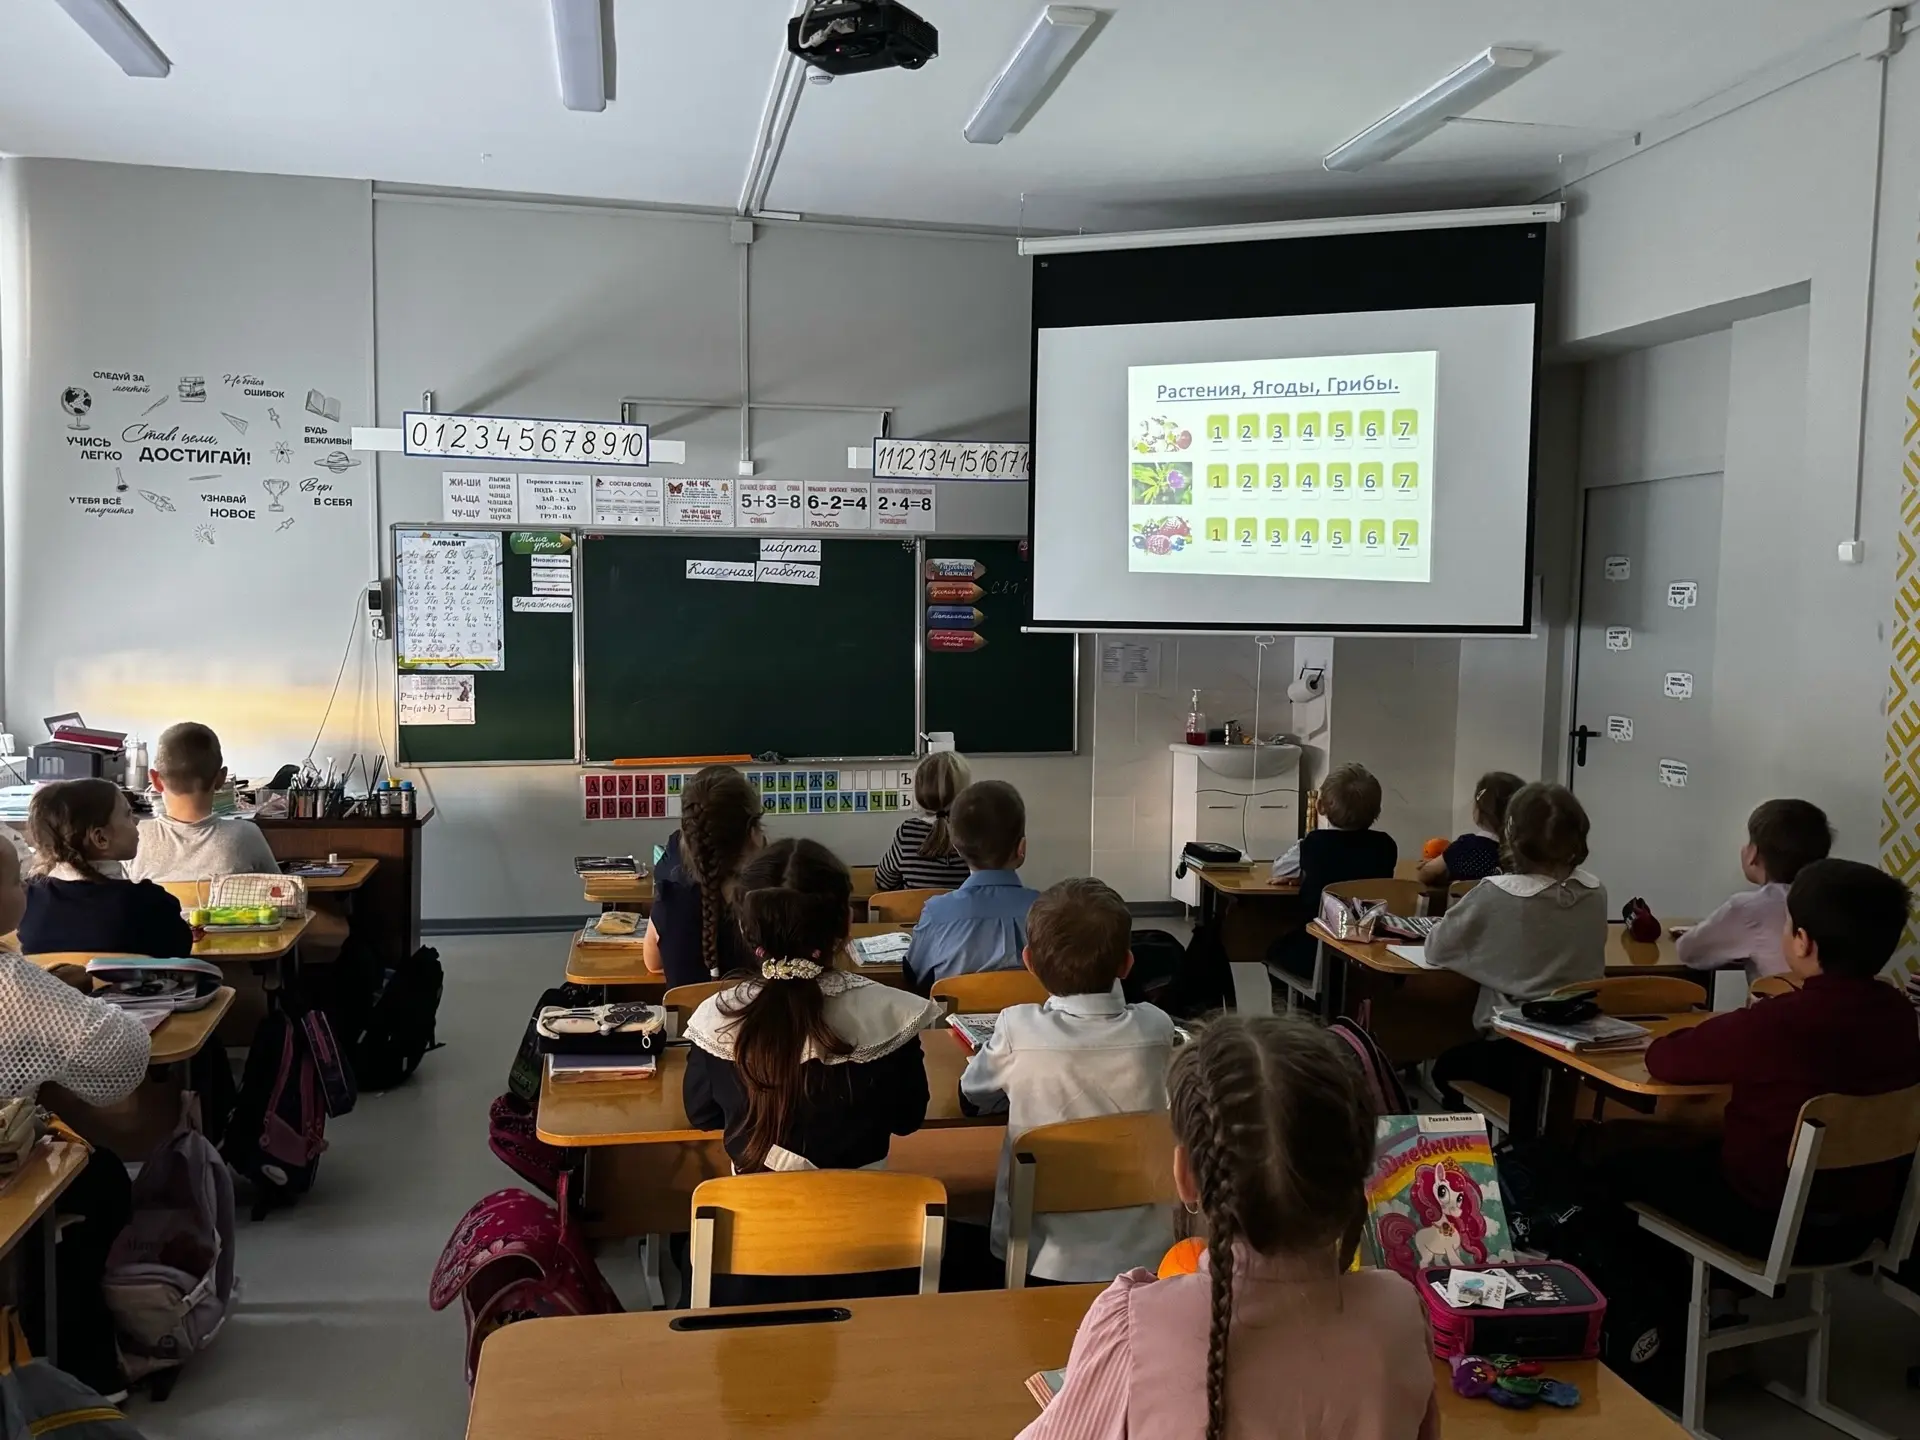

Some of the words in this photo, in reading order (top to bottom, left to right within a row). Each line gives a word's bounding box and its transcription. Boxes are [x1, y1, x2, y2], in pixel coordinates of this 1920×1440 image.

[93, 371, 130, 381] СЛЕДУЙ
[132, 374, 144, 382] ЗА
[1157, 383, 1246, 399] Растения,
[1252, 380, 1321, 397] Ягоды,
[1328, 375, 1399, 394] Грибы.
[244, 388, 285, 398] ОШИБОК
[304, 426, 328, 434] БУДЬ
[1214, 426, 1222, 439] 1
[1242, 426, 1251, 439] 2
[1273, 425, 1282, 438] 3
[1303, 424, 1314, 437] 4
[1334, 424, 1344, 438] 5
[1366, 423, 1376, 437] 6
[1400, 422, 1410, 436] 7
[66, 436, 112, 447] УЧИСЬ
[412, 422, 428, 446] 0
[436, 424, 445, 447] 1
[450, 424, 467, 448] 2
[475, 425, 489, 450] 3
[496, 426, 510, 450] 4
[519, 428, 534, 452] 5
[542, 428, 556, 452] 6
[562, 430, 576, 453] 7
[582, 431, 596, 454] 8
[602, 432, 616, 455] 9
[622, 433, 643, 456] 10
[80, 450, 122, 461] ЛЕГКО
[138, 447, 251, 465] ДОСТИГАЙ!
[879, 447, 895, 469] 11
[897, 448, 915, 470] 12
[918, 448, 936, 471] 13
[939, 450, 956, 472] 14
[960, 450, 977, 472] 15
[980, 450, 998, 472] 16
[1000, 450, 1019, 473] 17
[449, 478, 481, 487] ЖИ-ШИ
[1213, 476, 1222, 488] 1
[1243, 475, 1252, 488] 2
[1272, 475, 1282, 488] 3
[1302, 475, 1312, 488] 4
[1334, 474, 1344, 488] 5
[1365, 474, 1376, 488] 6
[1400, 474, 1410, 488] 7
[69, 497, 76, 505] У
[76, 497, 101, 505] ТЕБЯ
[102, 496, 122, 505] ВСЁ
[200, 494, 247, 504] УЗНАВАЙ
[313, 497, 321, 506] В
[323, 498, 353, 507] СЕБЯ
[451, 494, 480, 503] ЧА-ЩА
[742, 494, 800, 508] 5+3=8
[808, 495, 867, 510] 6-2=4
[210, 508, 256, 519] НОВОЕ
[452, 509, 480, 518] ЧУ-ЩУ
[811, 520, 839, 528] РАЗНОСТЬ
[518, 532, 548, 543] Тема
[1212, 529, 1221, 541] 1
[1242, 530, 1251, 543] 2
[1272, 530, 1281, 543] 3
[1302, 531, 1311, 544] 4
[1333, 532, 1342, 544] 5
[1367, 531, 1377, 544] 6
[1399, 533, 1409, 546] 7
[534, 541, 563, 551] урока
[688, 562, 754, 577] Классная
[514, 598, 571, 611] Упражнение
[588, 780, 598, 792] А
[604, 780, 614, 792] О
[621, 779, 632, 792] У
[636, 778, 649, 792] Ы
[654, 778, 663, 791] Э
[669, 778, 680, 791] Л
[766, 776, 774, 788] В
[782, 775, 790, 787] Г
[795, 775, 806, 790] Д
[810, 775, 822, 787] Ж
[827, 775, 835, 787] З
[902, 773, 911, 785] Ъ
[764, 797, 776, 810] Ф
[780, 797, 790, 809] К
[795, 797, 806, 809] Т
[810, 796, 822, 808] Ш
[827, 796, 836, 808] С
[841, 796, 852, 808] Х
[856, 796, 867, 810] Ц
[872, 795, 881, 807] Ч
[902, 795, 911, 806] Ь
[1377, 1135, 1473, 1177] Дневник
